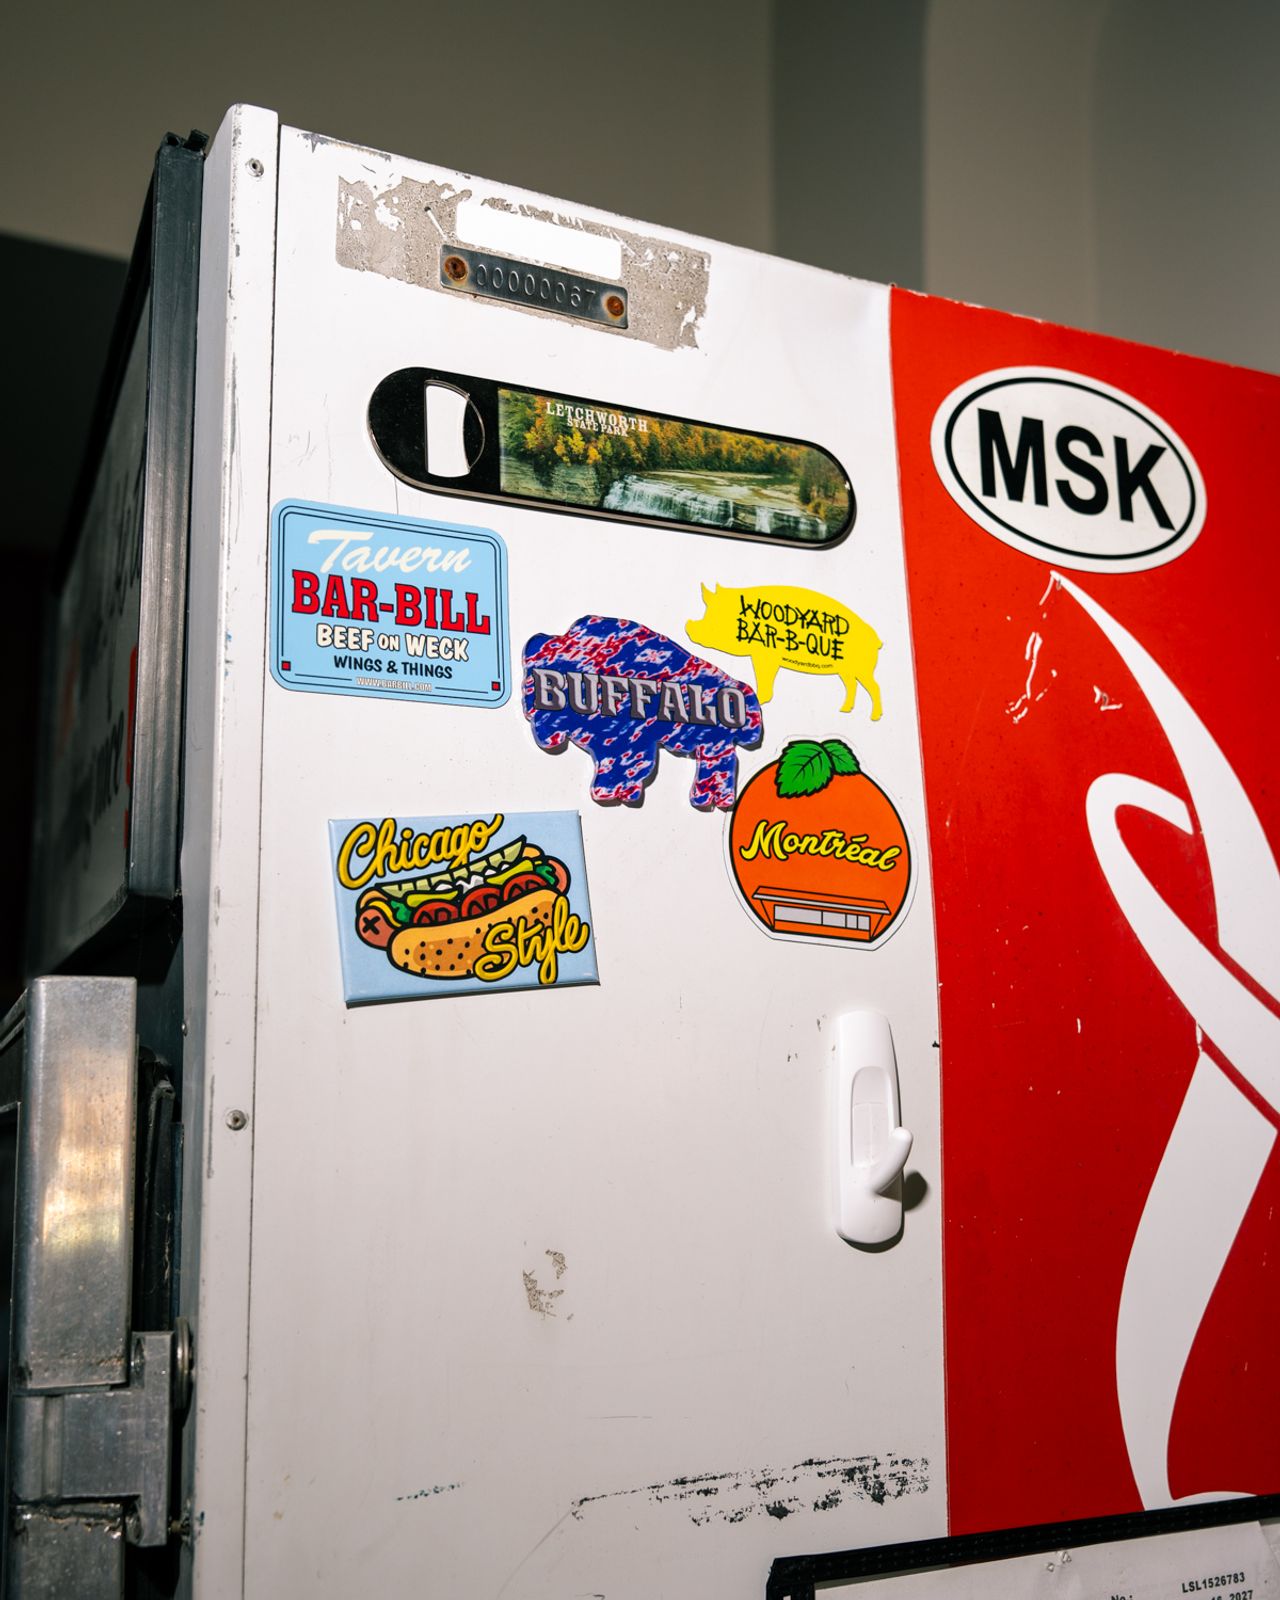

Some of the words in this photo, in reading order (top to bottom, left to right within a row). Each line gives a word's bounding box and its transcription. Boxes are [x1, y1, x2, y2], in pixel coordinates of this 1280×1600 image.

[476, 263, 597, 311] 00000067
[546, 402, 648, 432] LETCHWORTH
[567, 416, 599, 432] STATE
[600, 423, 628, 437] PARK
[977, 407, 1176, 532] MSK
[307, 529, 472, 574] Tavern
[292, 569, 491, 635] BAR-BILL
[739, 595, 850, 637] WOODYARD
[316, 623, 374, 651] BEEF
[377, 633, 401, 651] ON
[405, 633, 469, 662] WECK
[736, 618, 844, 660] BAR-B-QUE
[334, 655, 382, 673] WINGS
[387, 660, 398, 674] &
[401, 661, 453, 679] THINGS
[532, 668, 746, 728] BUFFALO
[337, 813, 504, 890] Chicago
[740, 820, 902, 871] Montréal
[473, 895, 590, 984] Style
[1182, 1571, 1245, 1593] LSL1526783
[1229, 1589, 1253, 1600] 2027
